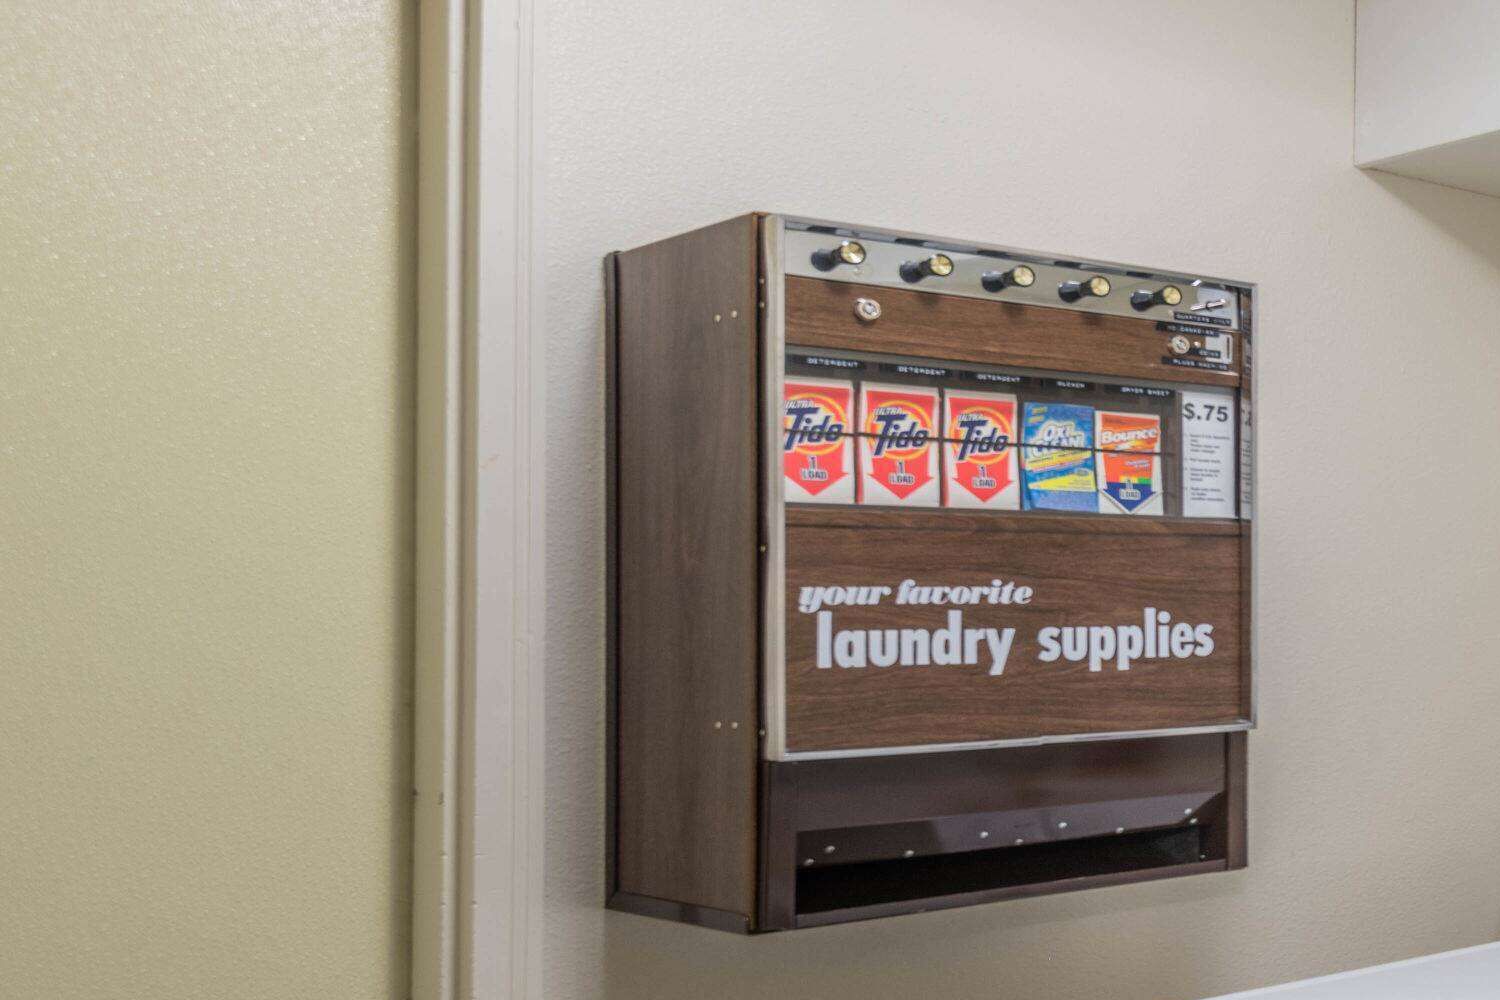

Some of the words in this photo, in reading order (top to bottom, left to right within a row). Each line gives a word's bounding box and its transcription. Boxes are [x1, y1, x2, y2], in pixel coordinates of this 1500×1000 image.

[784, 407, 844, 451] Tide
[1182, 403, 1229, 423] $.75
[873, 413, 930, 456] Tide
[958, 419, 1009, 461] Tide
[1101, 427, 1158, 445] Bounce
[799, 584, 891, 613] your
[895, 579, 1034, 605] favorite
[816, 609, 1016, 676] laundry
[1037, 606, 1215, 672] supplies
